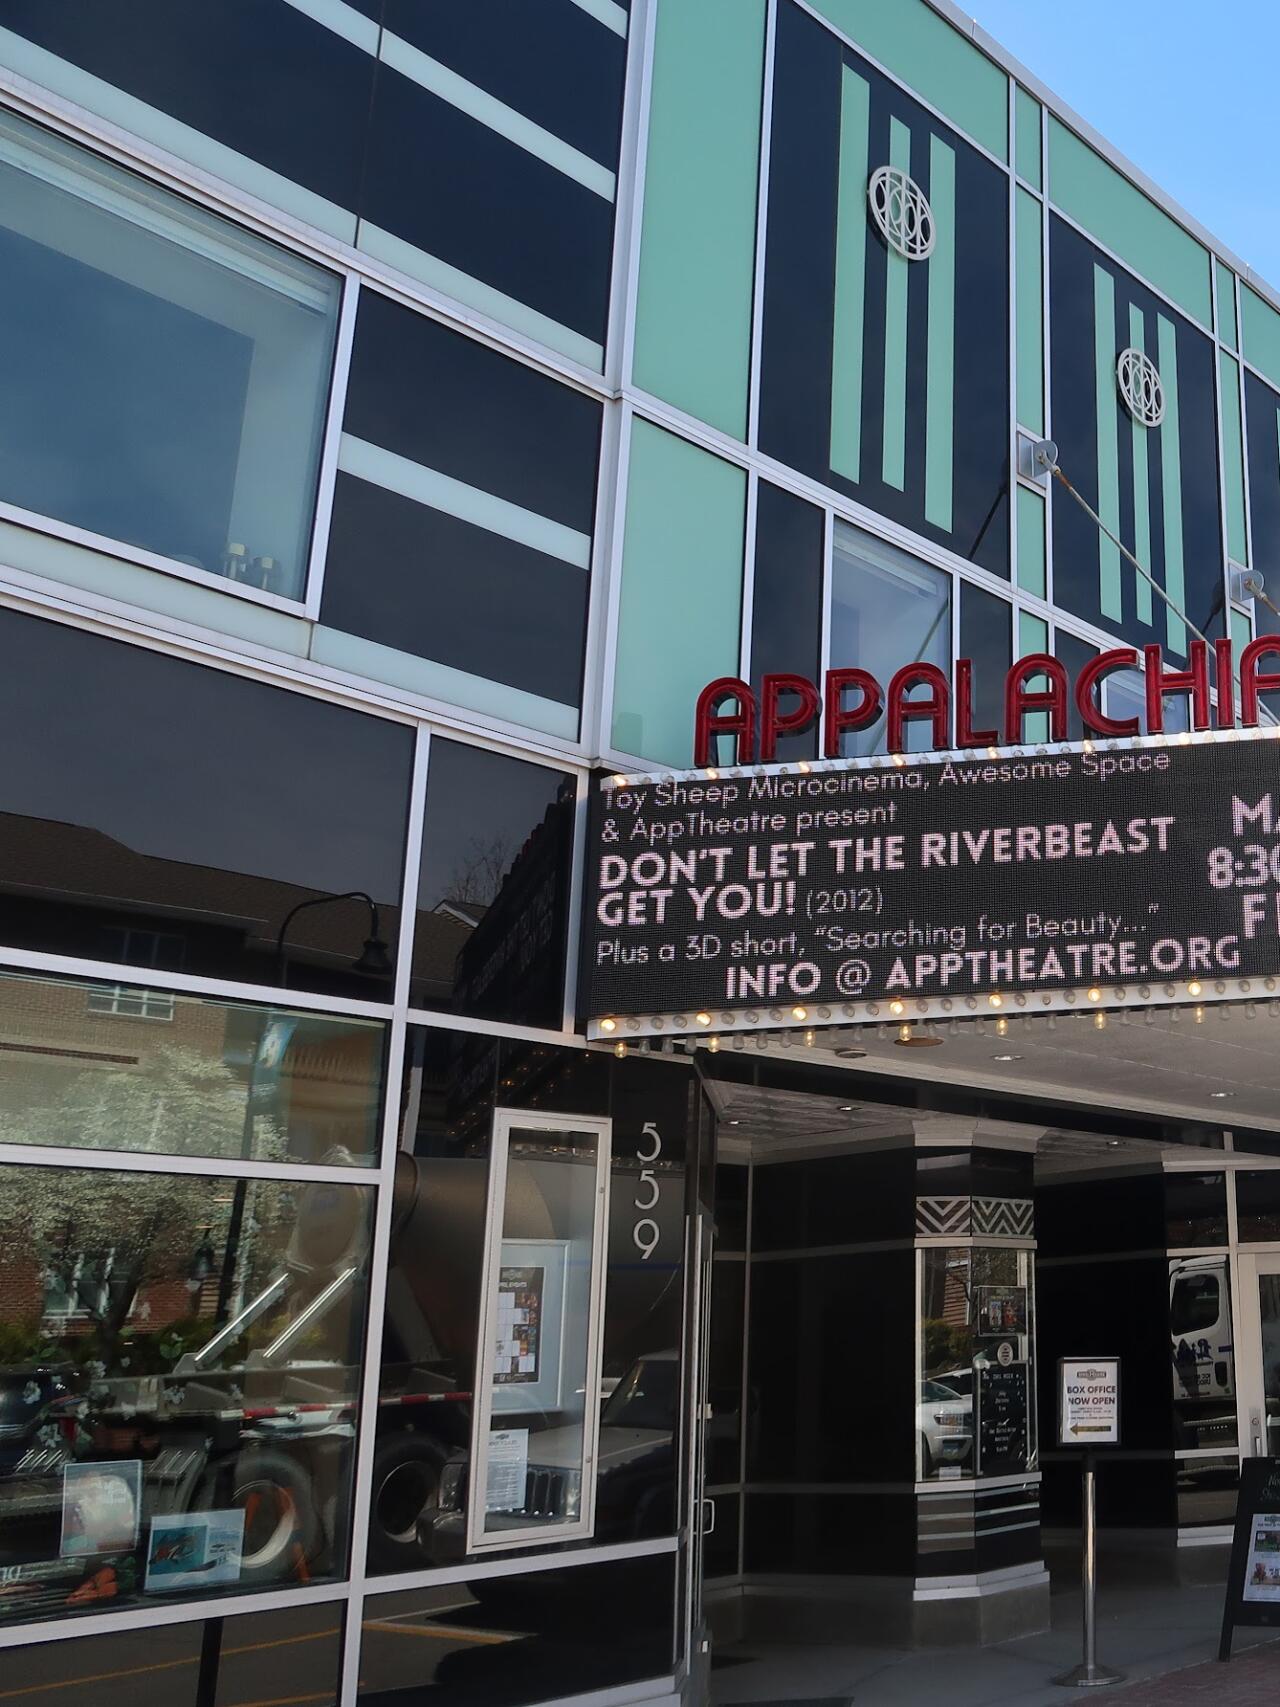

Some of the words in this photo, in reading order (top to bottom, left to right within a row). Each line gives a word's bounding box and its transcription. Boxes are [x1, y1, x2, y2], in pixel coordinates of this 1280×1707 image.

[603, 786, 648, 815] Toy
[655, 777, 738, 809] Sheep
[748, 769, 930, 801] Microcinema,
[939, 760, 1072, 786] Awesome
[1080, 752, 1170, 782] Space
[600, 821, 620, 843] &
[629, 810, 787, 846] AppTheatre
[796, 801, 899, 836] present
[599, 847, 734, 890] DON'T
[746, 841, 817, 880] LET
[828, 835, 906, 874] THE
[921, 815, 1176, 869] RIVERBEAST
[596, 888, 674, 928] GET
[686, 881, 797, 923] YOU!
[806, 887, 884, 916] (2012)
[597, 938, 649, 966] Plus
[658, 944, 675, 962] a
[685, 935, 722, 961] 3D
[731, 929, 806, 959] short,
[813, 919, 967, 952] “Searching
[977, 915, 1016, 943] for
[725, 962, 822, 1000] INFO
[835, 958, 873, 996] @
[884, 935, 1241, 989] APPTHEATRE.ORG
[633, 1122, 662, 1260] 559
[1067, 1386, 1086, 1394] BOX
[1087, 1385, 1116, 1394] OFFICE
[1068, 1397, 1090, 1405] NOW
[1092, 1397, 1116, 1405] OPEN
